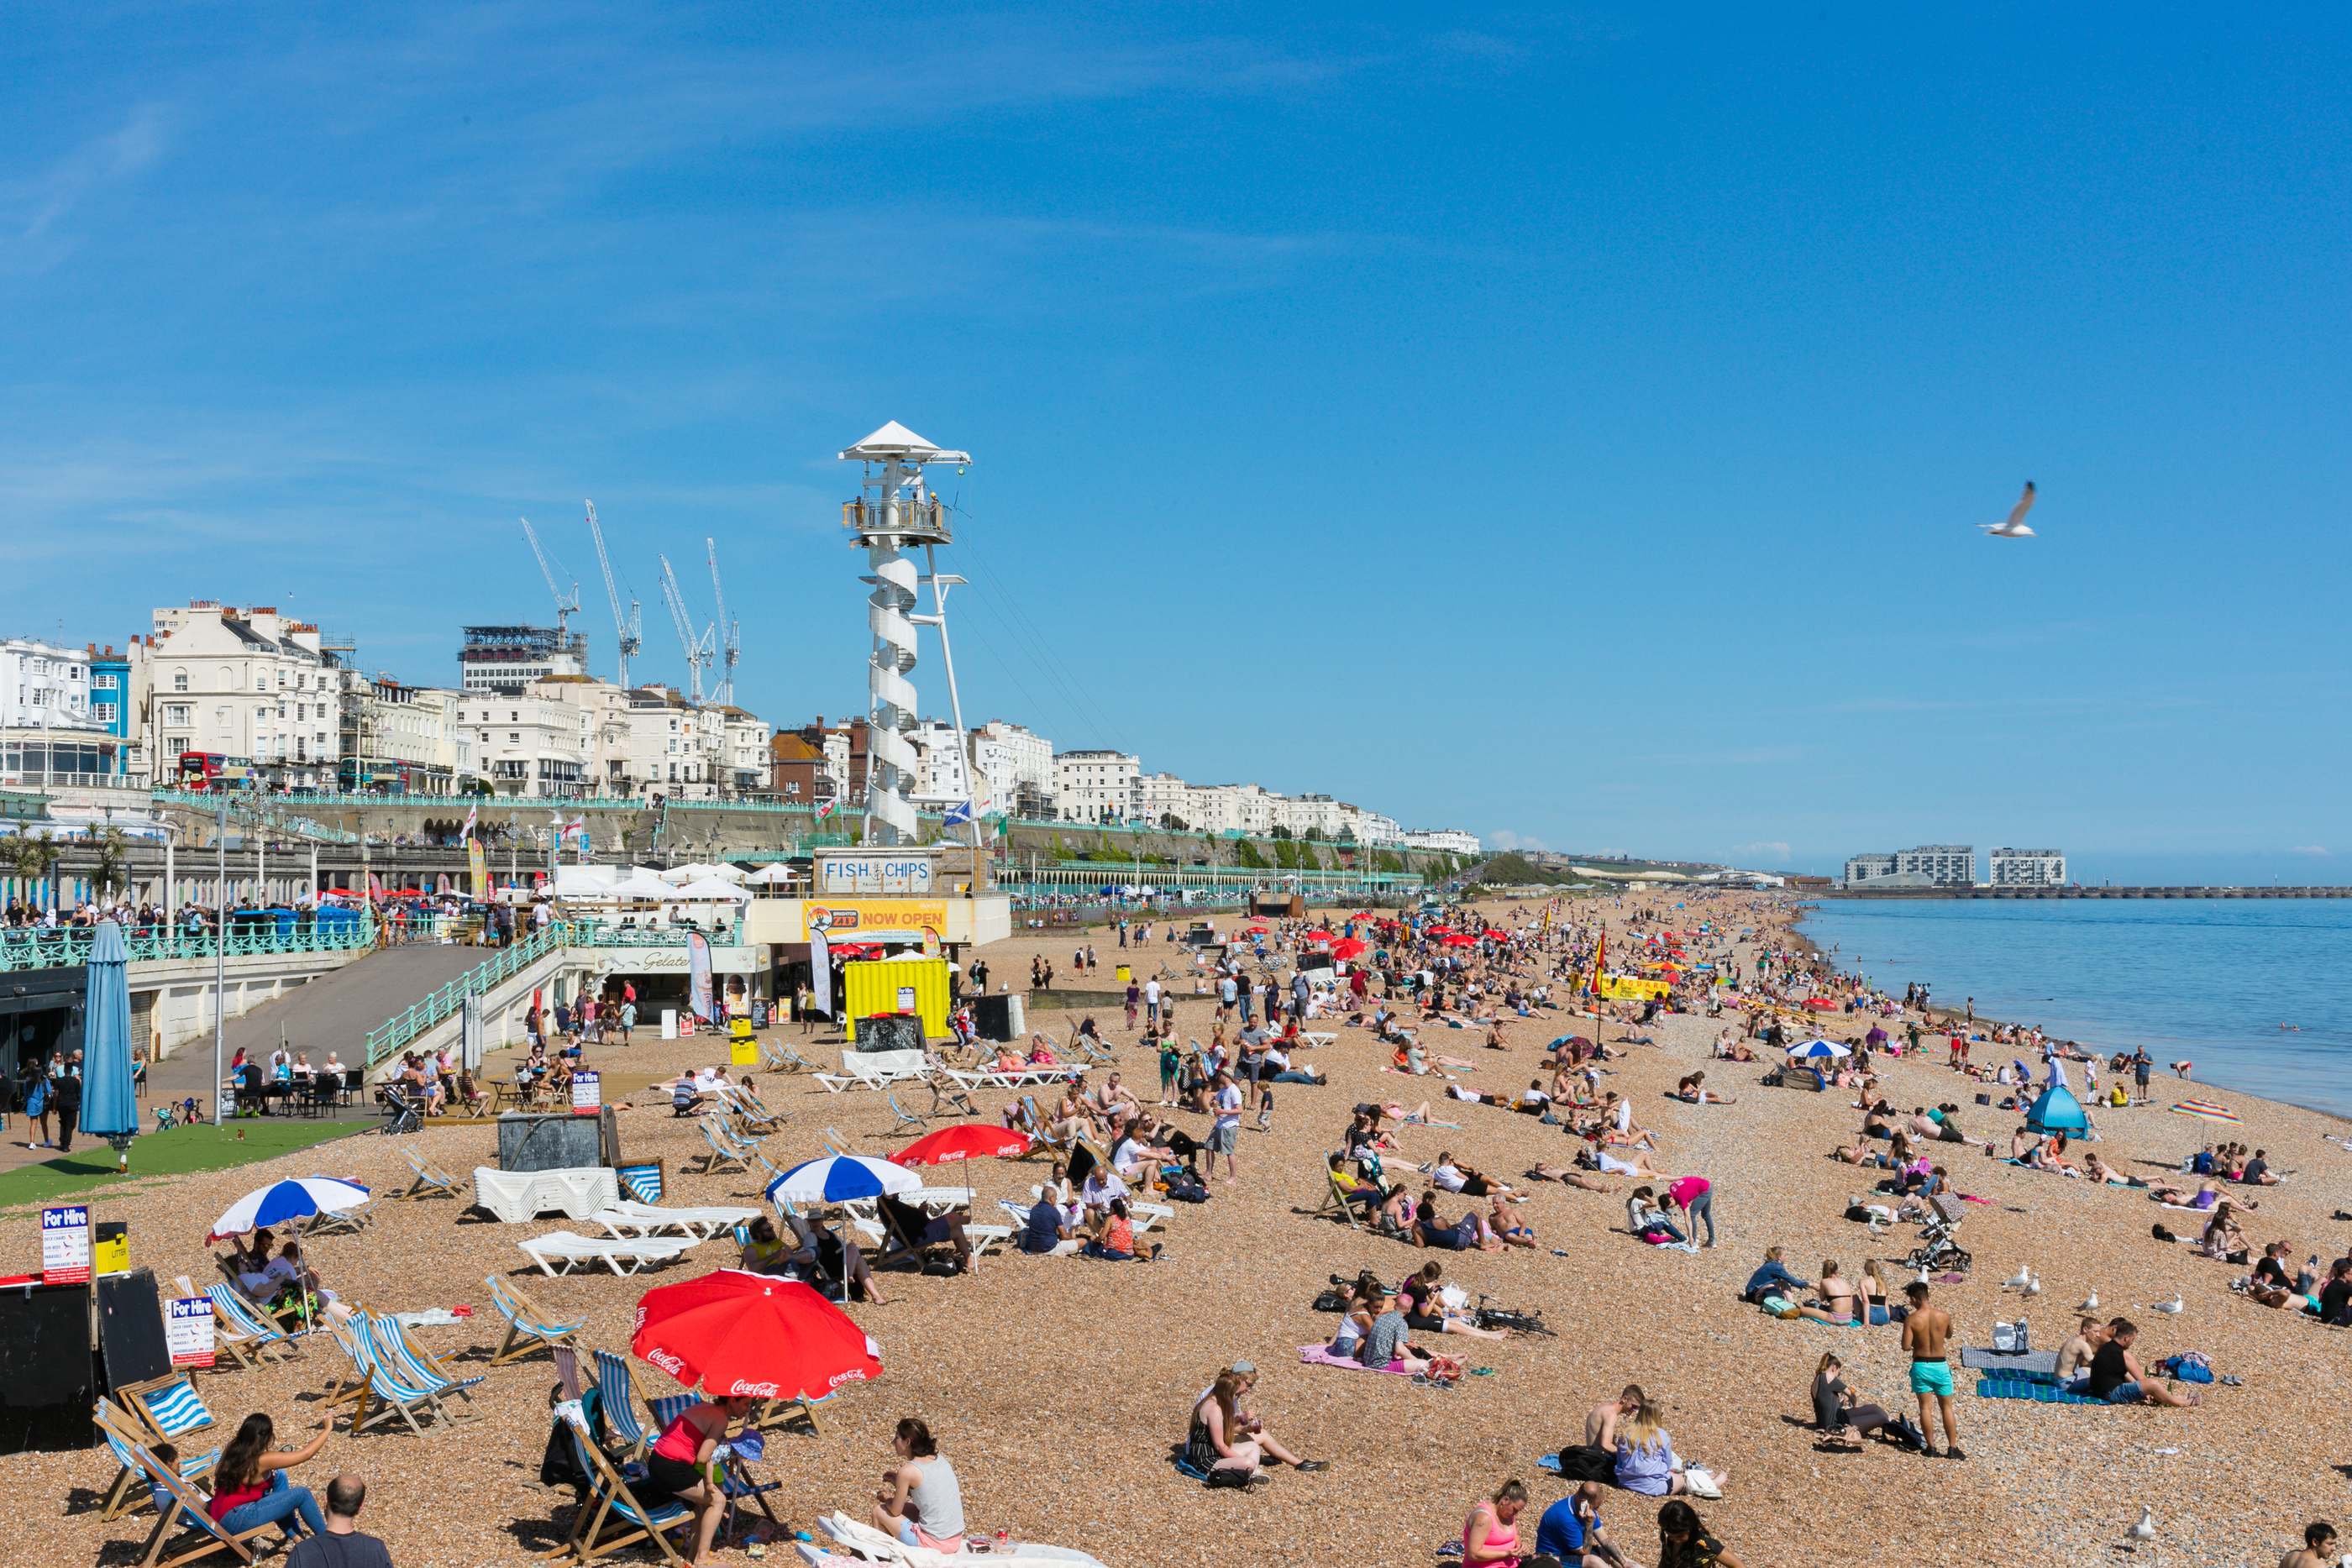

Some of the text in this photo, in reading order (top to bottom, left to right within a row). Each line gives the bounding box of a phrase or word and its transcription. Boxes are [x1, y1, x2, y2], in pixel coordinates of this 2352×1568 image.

[827, 863, 928, 878] FISH CHIPS
[832, 916, 856, 927] ZIP
[863, 913, 942, 925] NOW OPEN
[573, 1072, 598, 1083] For Hire
[44, 1208, 87, 1228] For Hire
[112, 1248, 126, 1258] LITTER
[173, 1298, 213, 1317] For Hire
